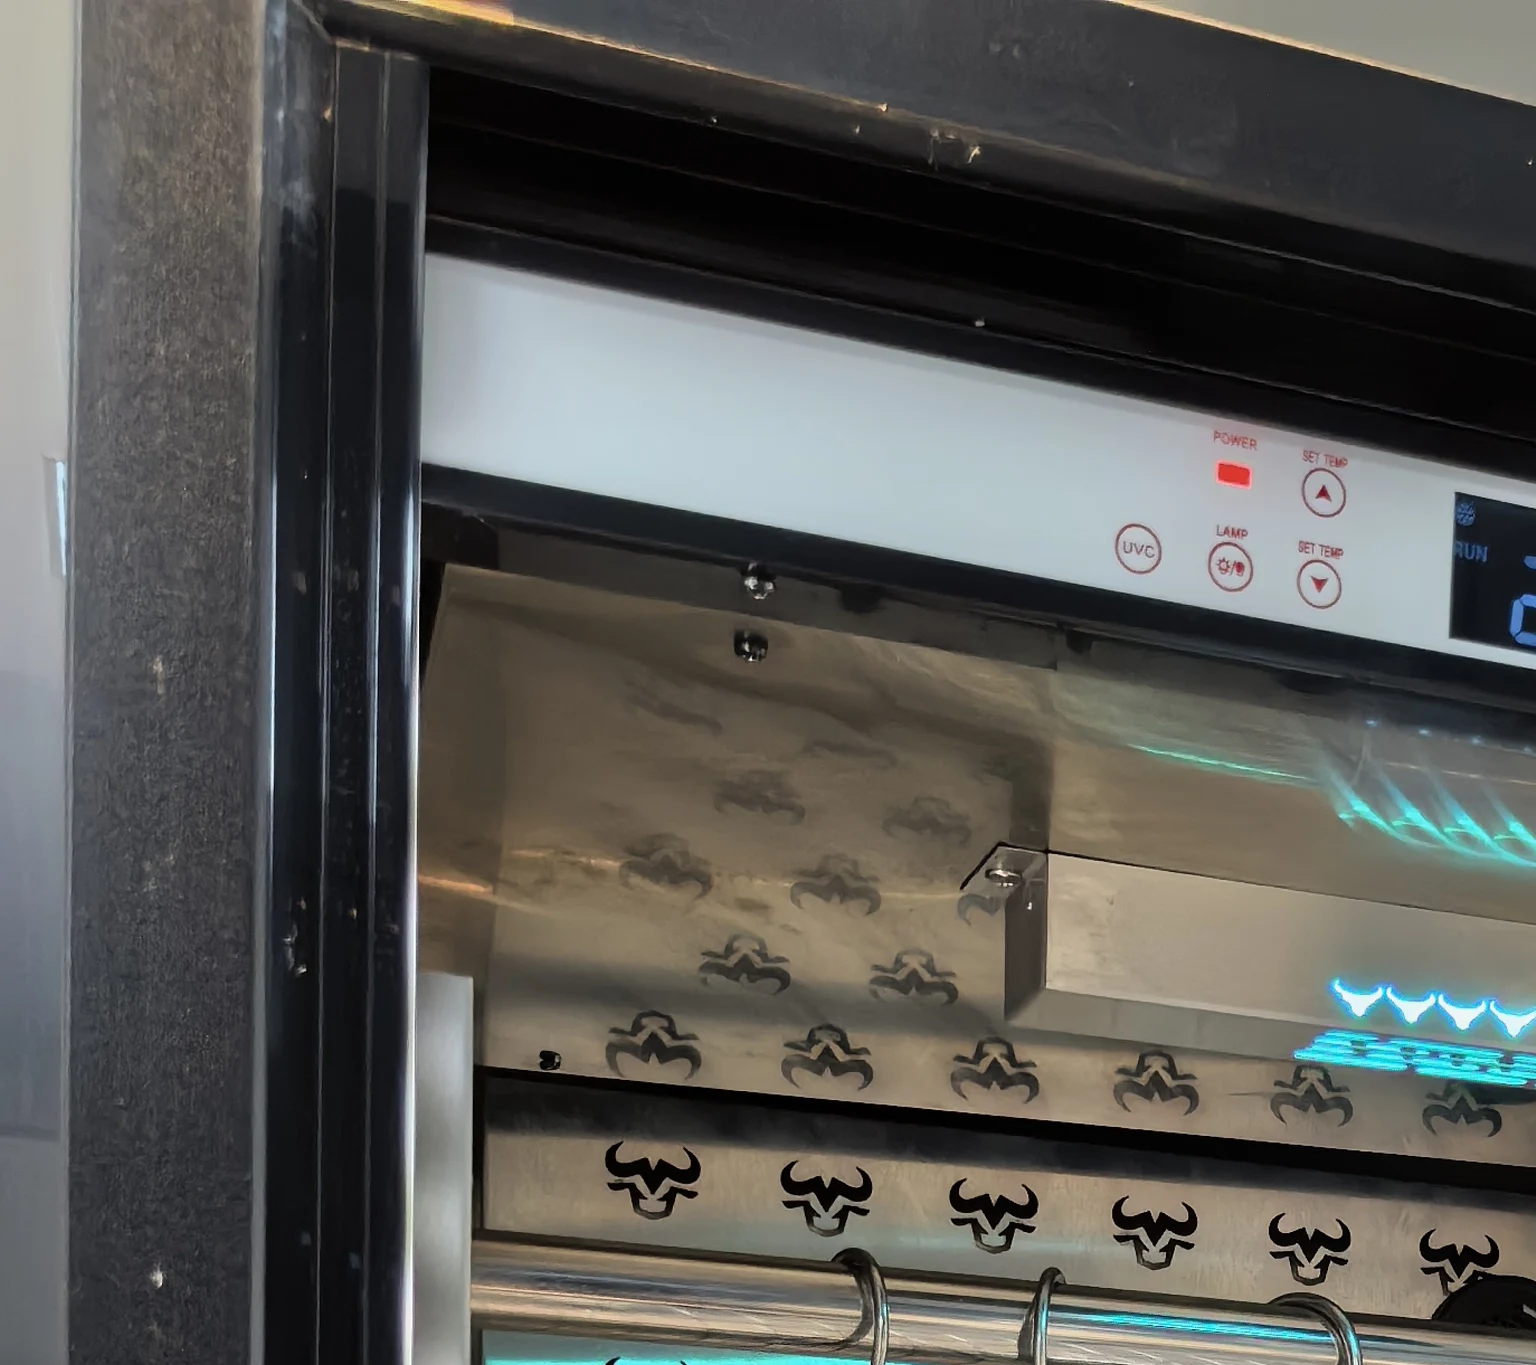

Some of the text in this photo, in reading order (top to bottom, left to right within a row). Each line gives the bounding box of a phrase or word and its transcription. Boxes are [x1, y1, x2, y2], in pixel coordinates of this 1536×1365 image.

[1213, 431, 1258, 451] POWER
[1302, 450, 1348, 468] SET TEMP
[1216, 524, 1248, 540] LAMP
[1122, 541, 1155, 559] UVC
[1298, 540, 1344, 559] SET TEMP
[1454, 541, 1488, 563] RUN
